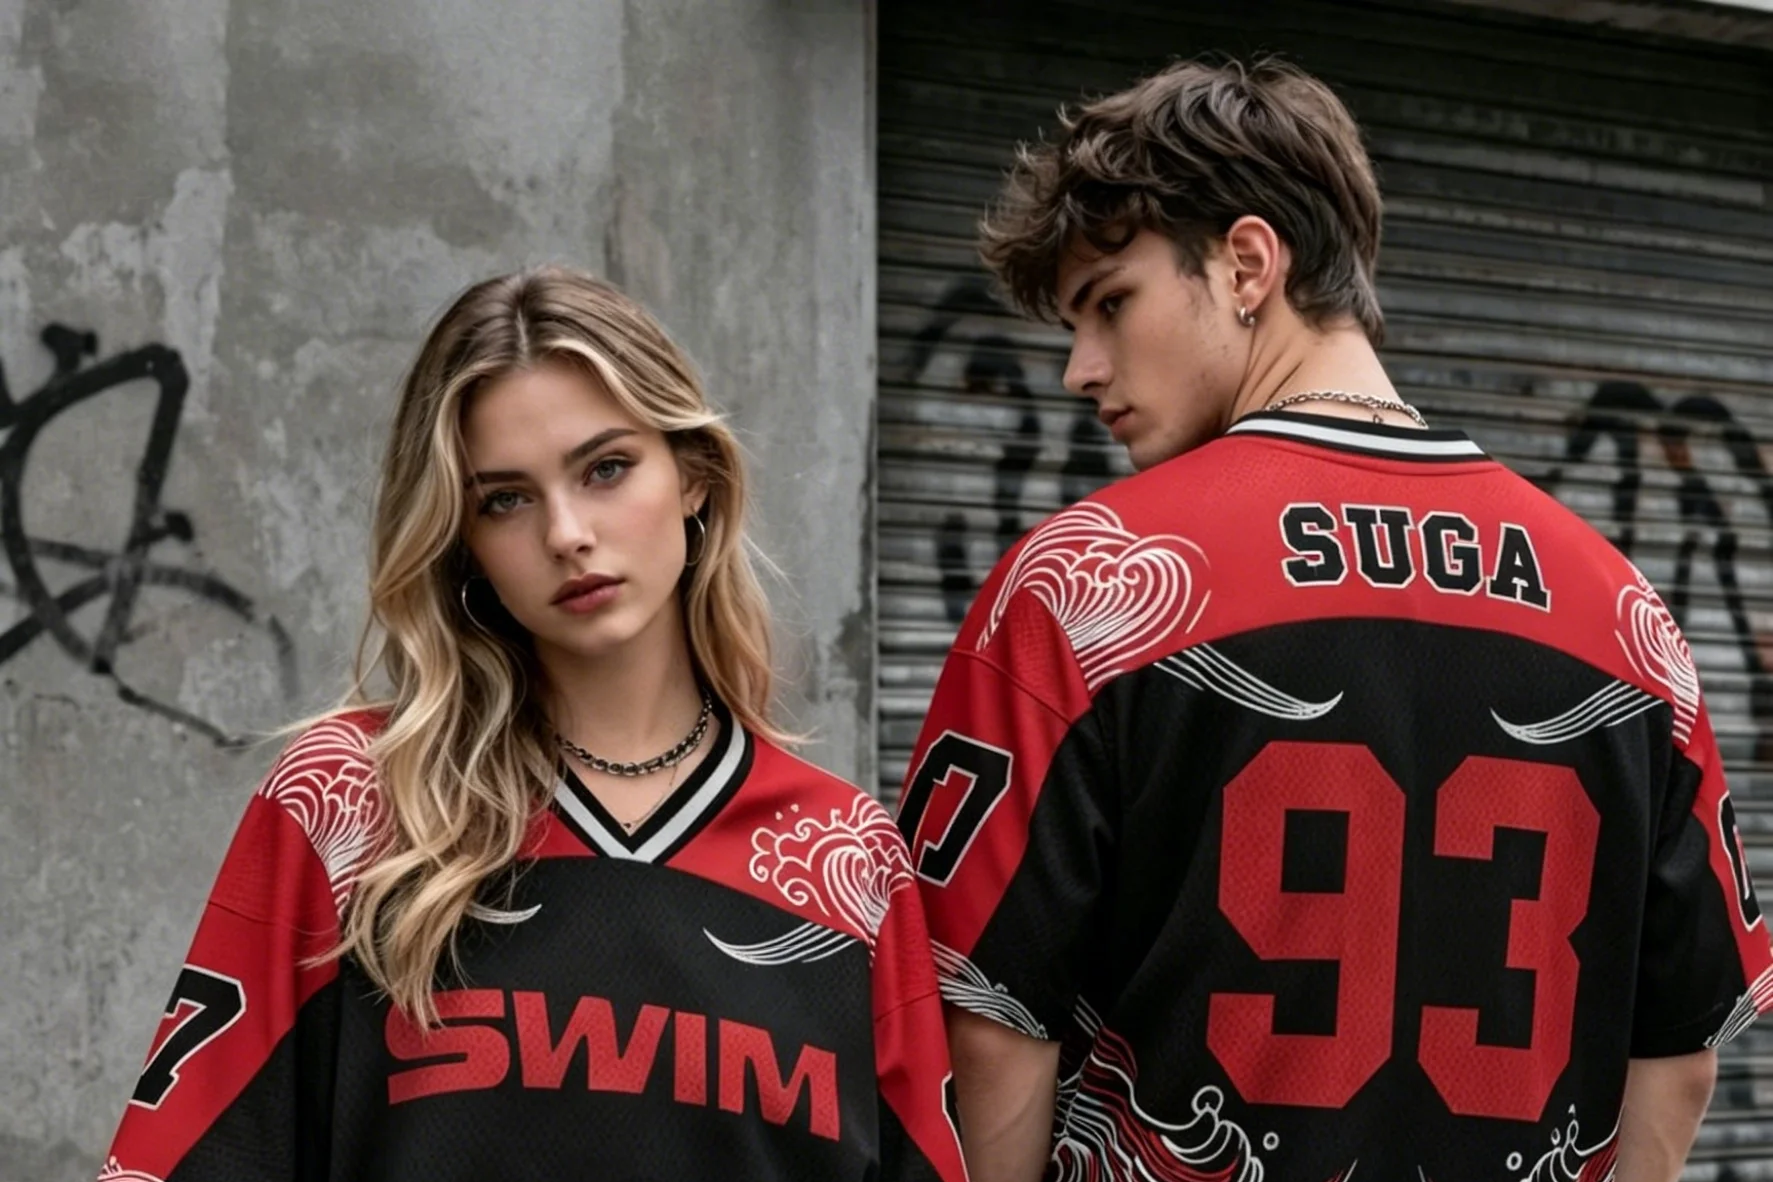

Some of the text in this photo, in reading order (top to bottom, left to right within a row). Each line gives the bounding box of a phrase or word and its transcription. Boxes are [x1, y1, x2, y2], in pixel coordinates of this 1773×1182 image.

[1279, 502, 1551, 613] SUGA
[1206, 740, 1601, 1122] 93
[128, 963, 247, 1111] 7
[384, 988, 840, 1142] SWIM
